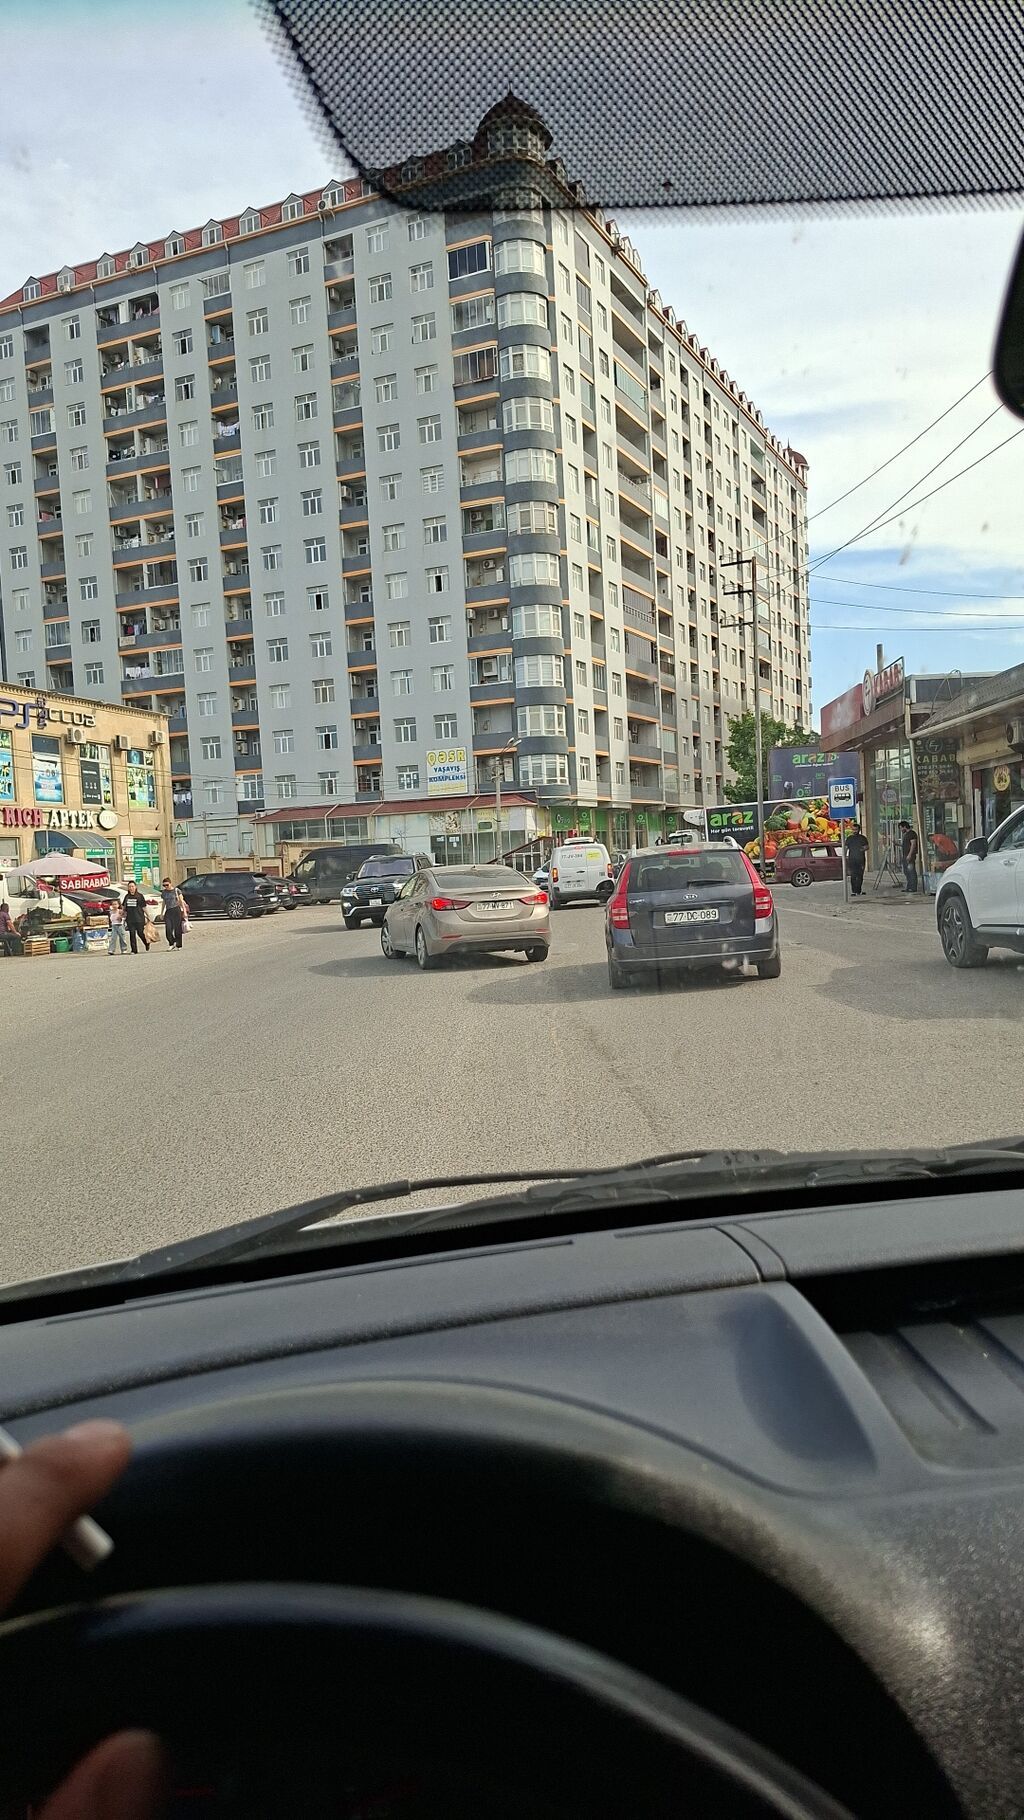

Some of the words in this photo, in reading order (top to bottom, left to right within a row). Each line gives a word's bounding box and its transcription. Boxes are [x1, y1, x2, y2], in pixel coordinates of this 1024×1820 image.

[49, 708, 96, 727] CLUB
[792, 753, 825, 765] araz
[834, 784, 850, 792] BUS
[4, 807, 42, 826] RICH
[50, 809, 94, 828] APTEK
[709, 810, 754, 827] araz
[60, 876, 109, 890] SABİRABAD
